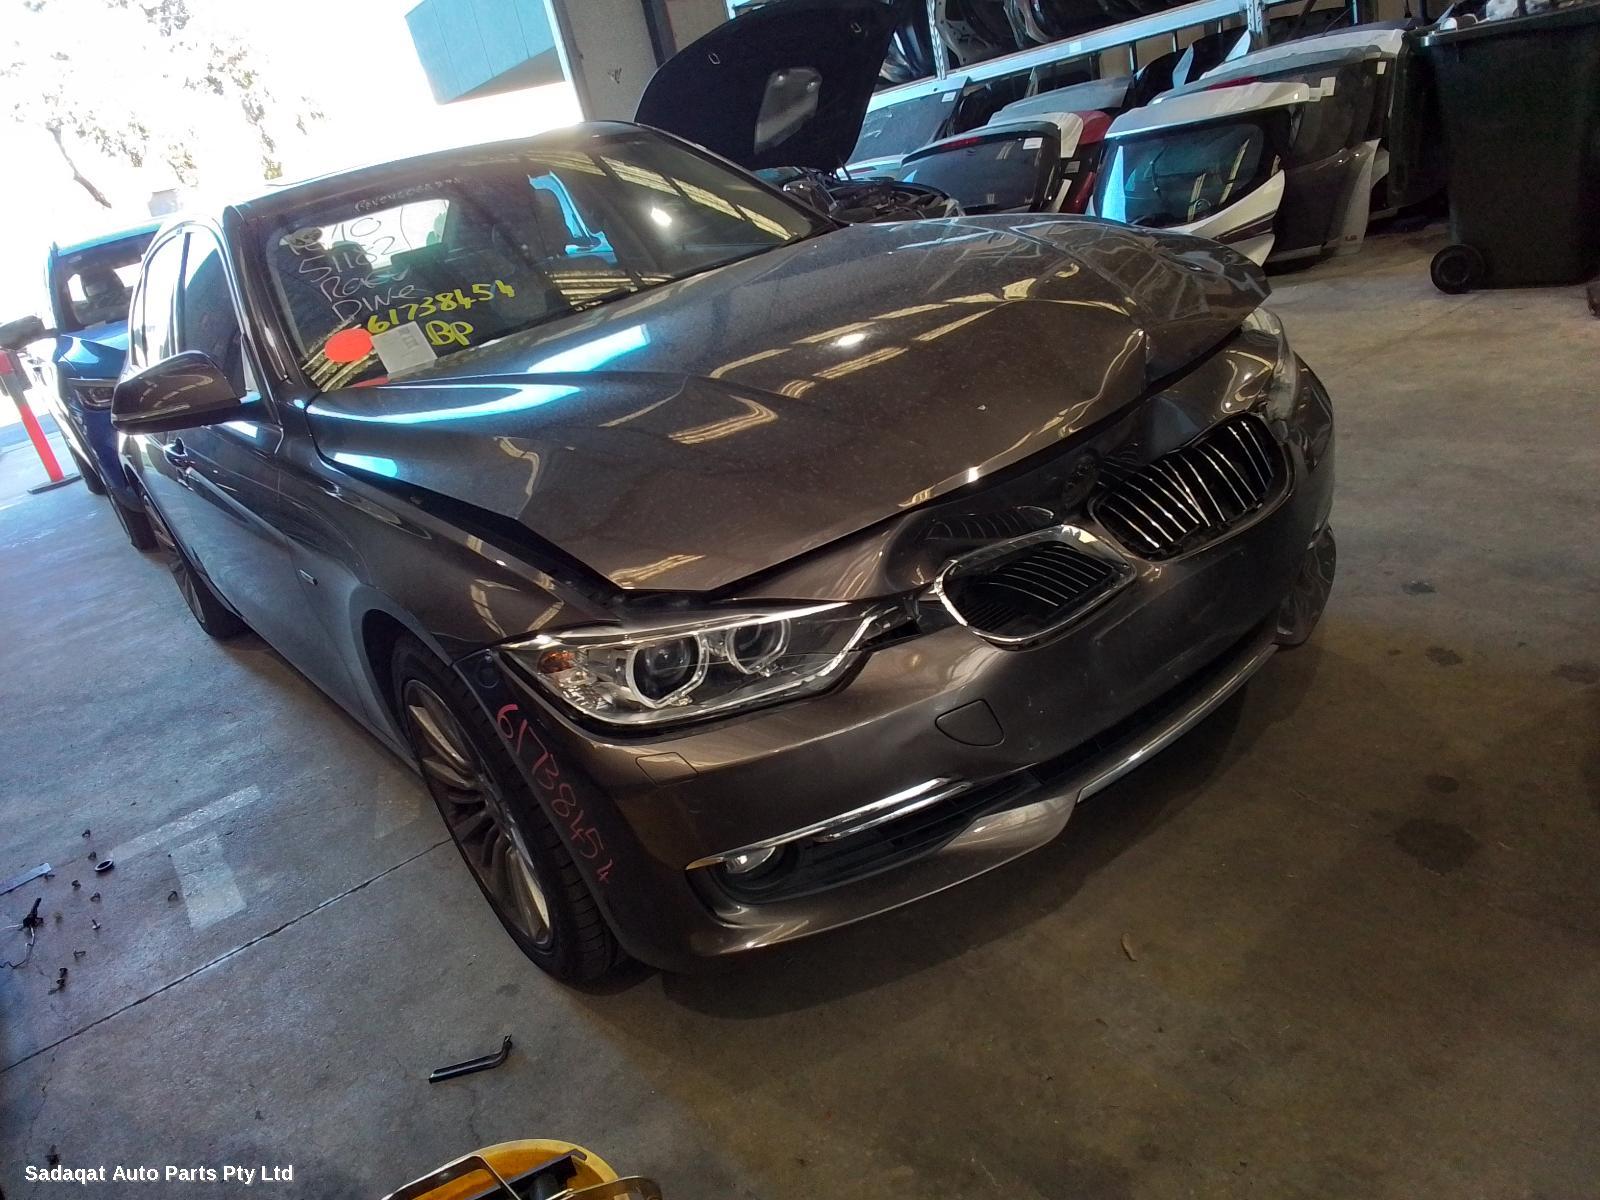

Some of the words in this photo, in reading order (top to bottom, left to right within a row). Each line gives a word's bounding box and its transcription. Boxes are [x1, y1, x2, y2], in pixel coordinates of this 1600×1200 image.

[367, 279, 516, 335] 61738454
[425, 320, 475, 346] BP
[497, 703, 614, 885] 61738454
